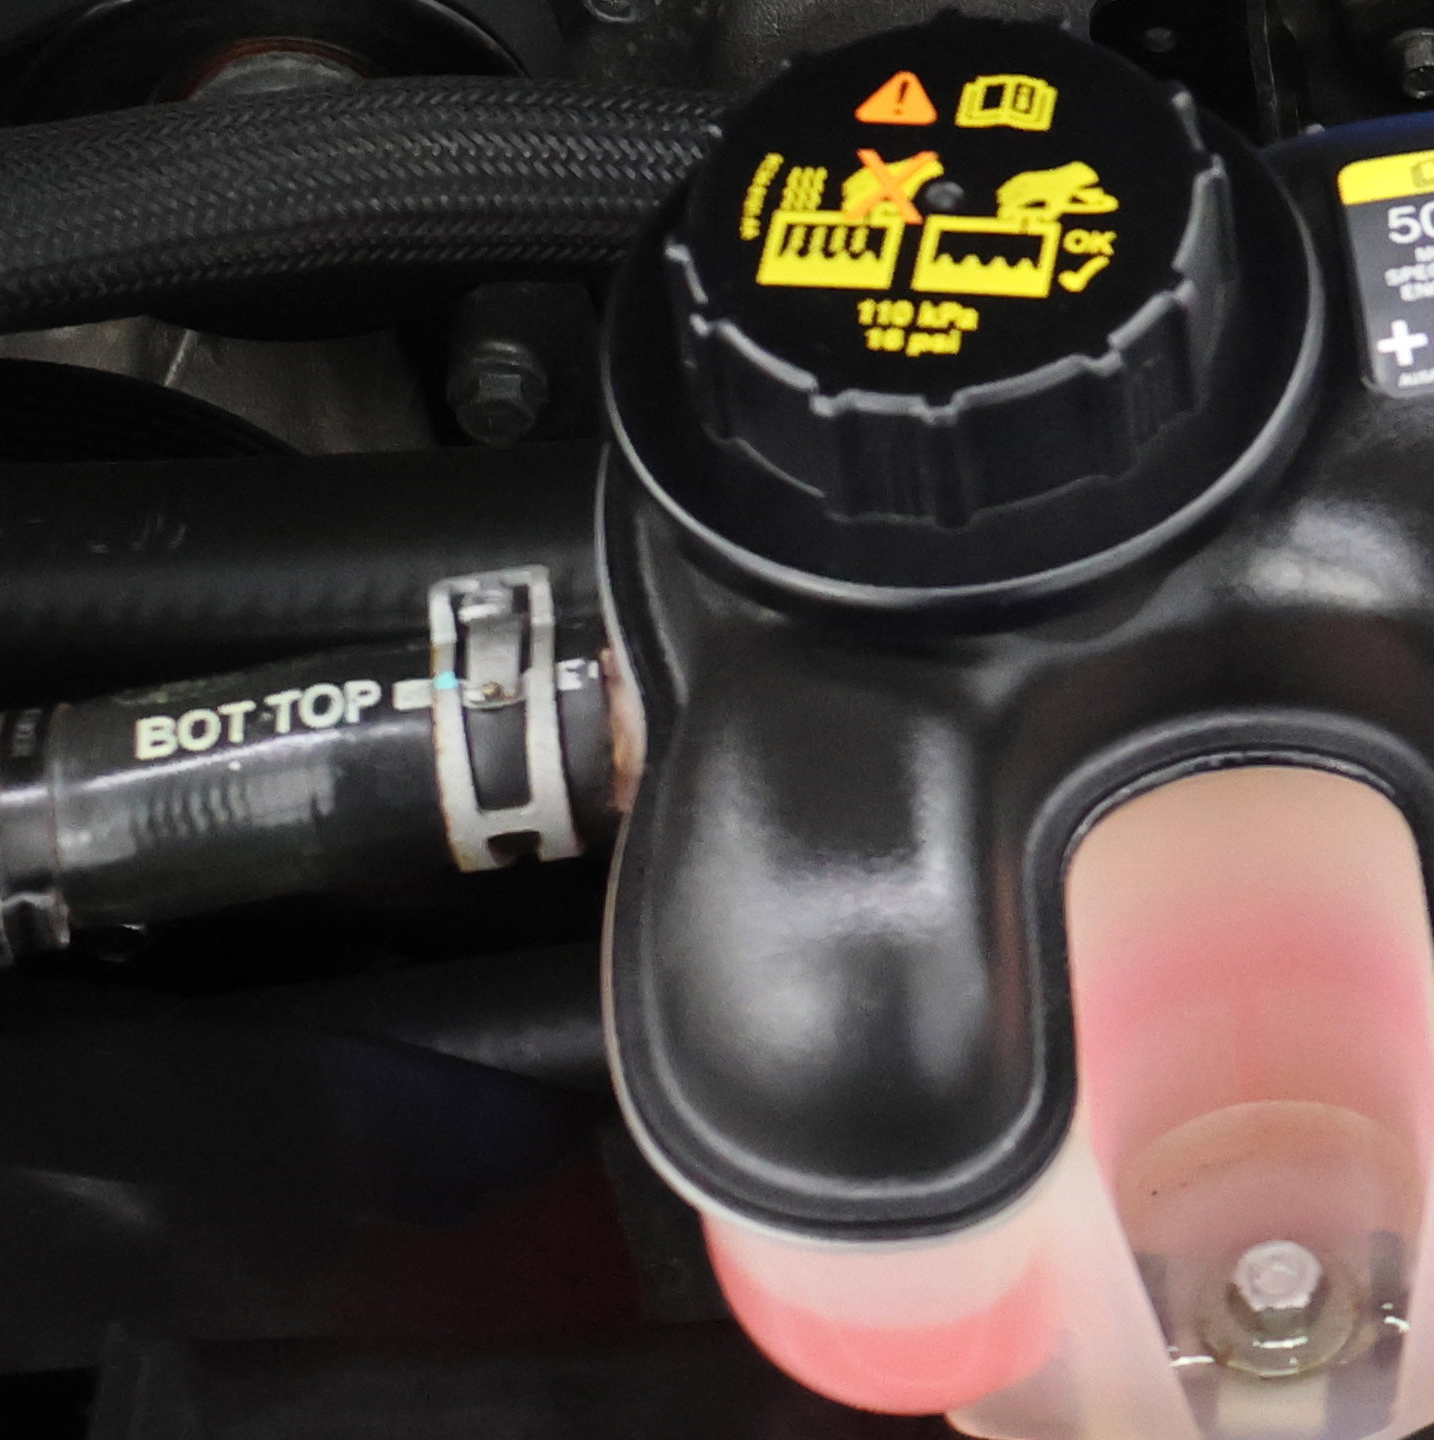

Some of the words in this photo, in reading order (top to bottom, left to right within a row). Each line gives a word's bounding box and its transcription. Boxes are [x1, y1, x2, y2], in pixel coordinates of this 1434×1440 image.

[1062, 228, 1117, 256] OK
[857, 298, 914, 328] 110
[917, 299, 980, 331] kPa
[906, 328, 963, 357] psi
[134, 699, 257, 760] BOT
[263, 678, 382, 735] TOP
